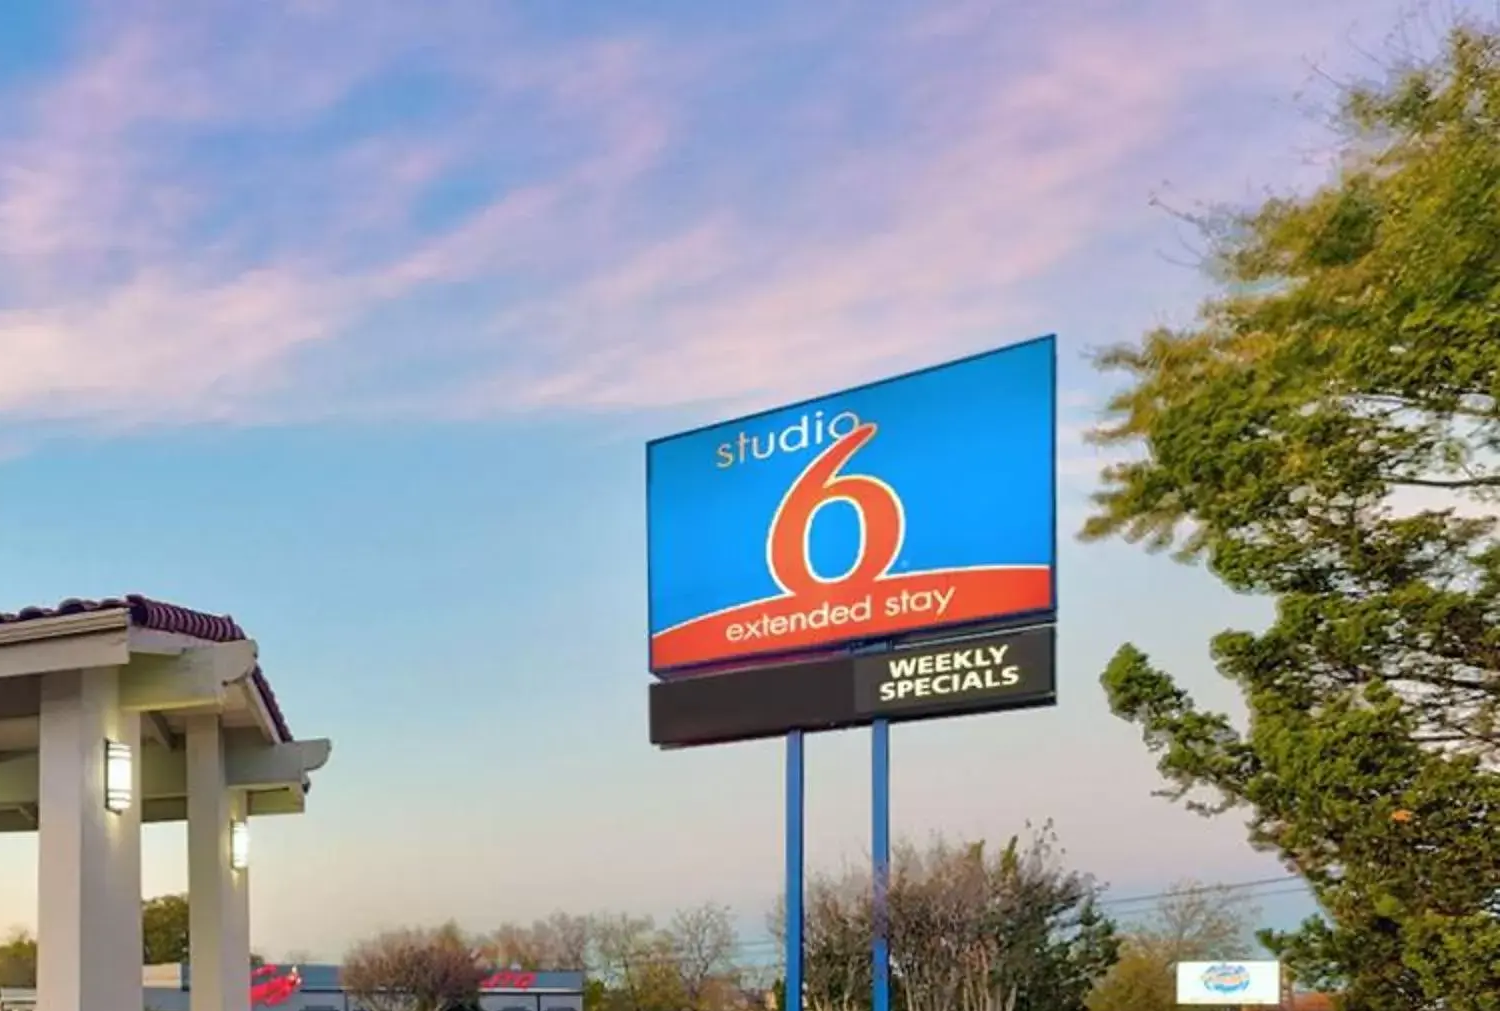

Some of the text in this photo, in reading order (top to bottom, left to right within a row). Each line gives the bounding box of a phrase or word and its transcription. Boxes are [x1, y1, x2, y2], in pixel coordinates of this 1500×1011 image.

[716, 410, 860, 468] studio
[766, 422, 906, 592] 6
[725, 586, 957, 641] extended stay
[879, 664, 1020, 701] SPECIALS
[888, 643, 1009, 679] WEEKLY
